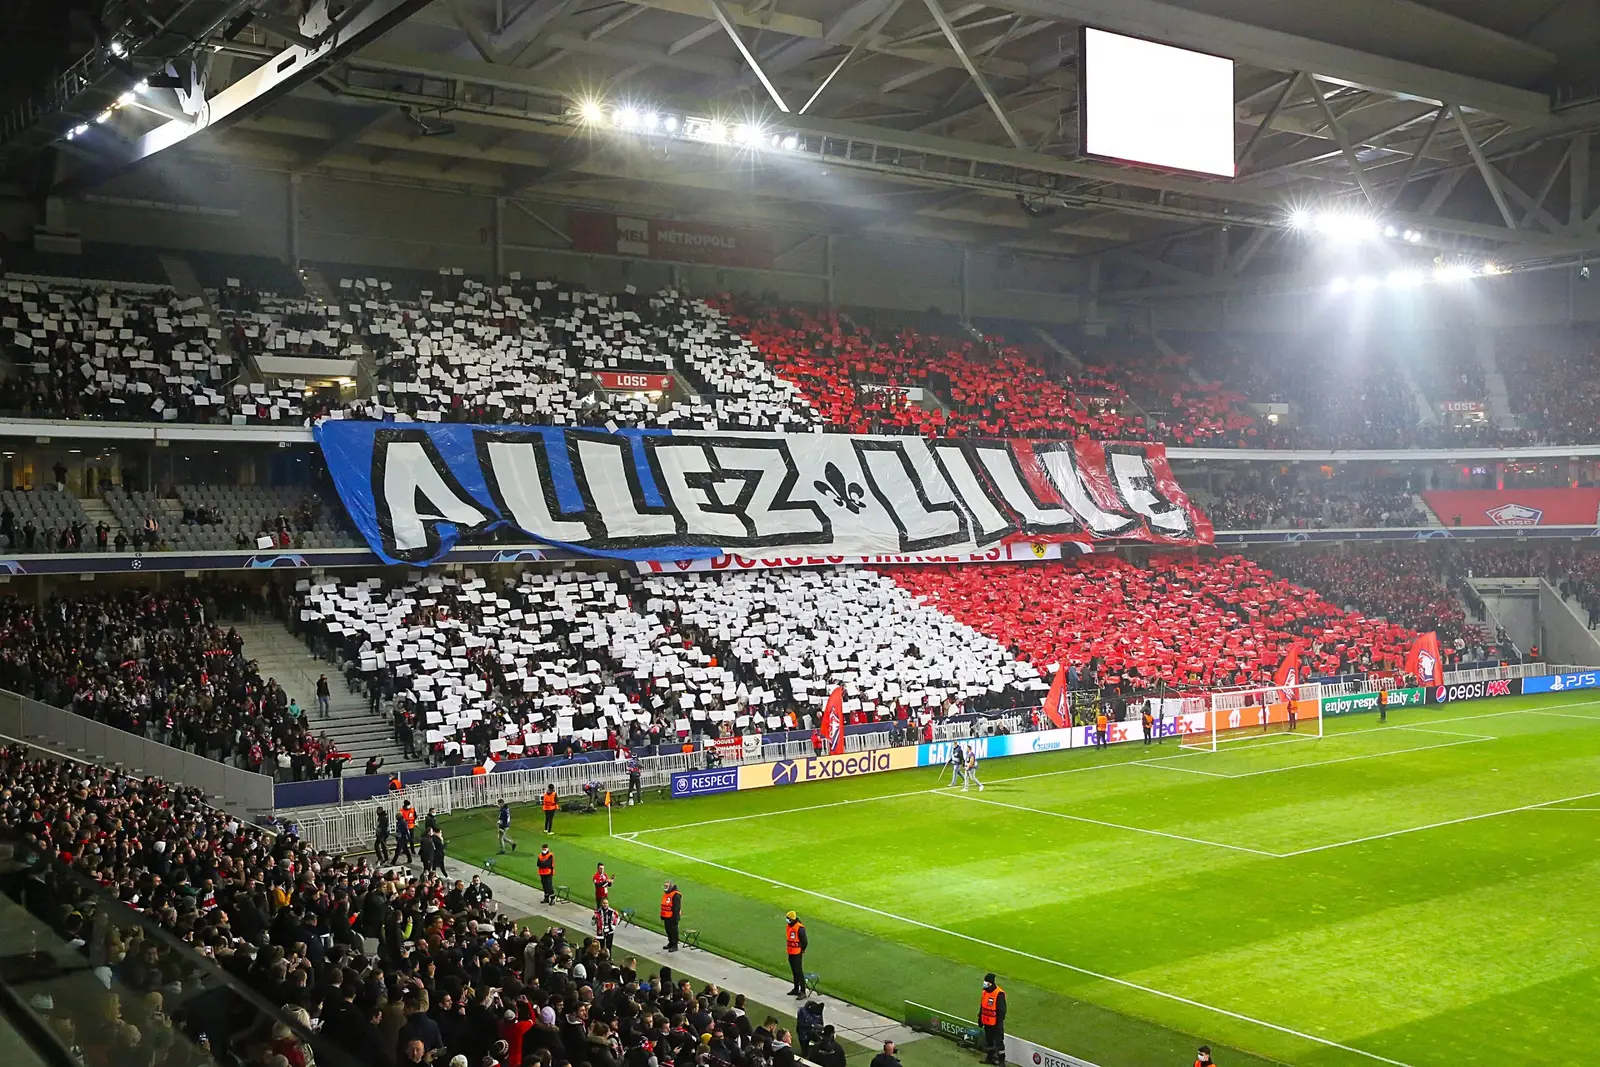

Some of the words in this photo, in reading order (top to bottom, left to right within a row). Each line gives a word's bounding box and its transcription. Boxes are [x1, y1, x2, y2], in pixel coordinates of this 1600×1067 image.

[658, 229, 736, 248] MÉTROPOLE
[617, 375, 647, 387] LOSC
[1448, 402, 1476, 411] LOSC
[371, 428, 834, 560] ALLEZ
[851, 437, 1203, 552] LILLE
[1566, 673, 1596, 687] PS5
[1448, 681, 1485, 702] pepsi
[1486, 679, 1512, 697] MAX
[1325, 698, 1352, 714] enjoy
[1152, 715, 1193, 737] FedEx
[805, 749, 891, 779] Expedia
[692, 773, 736, 789] RESPECT
